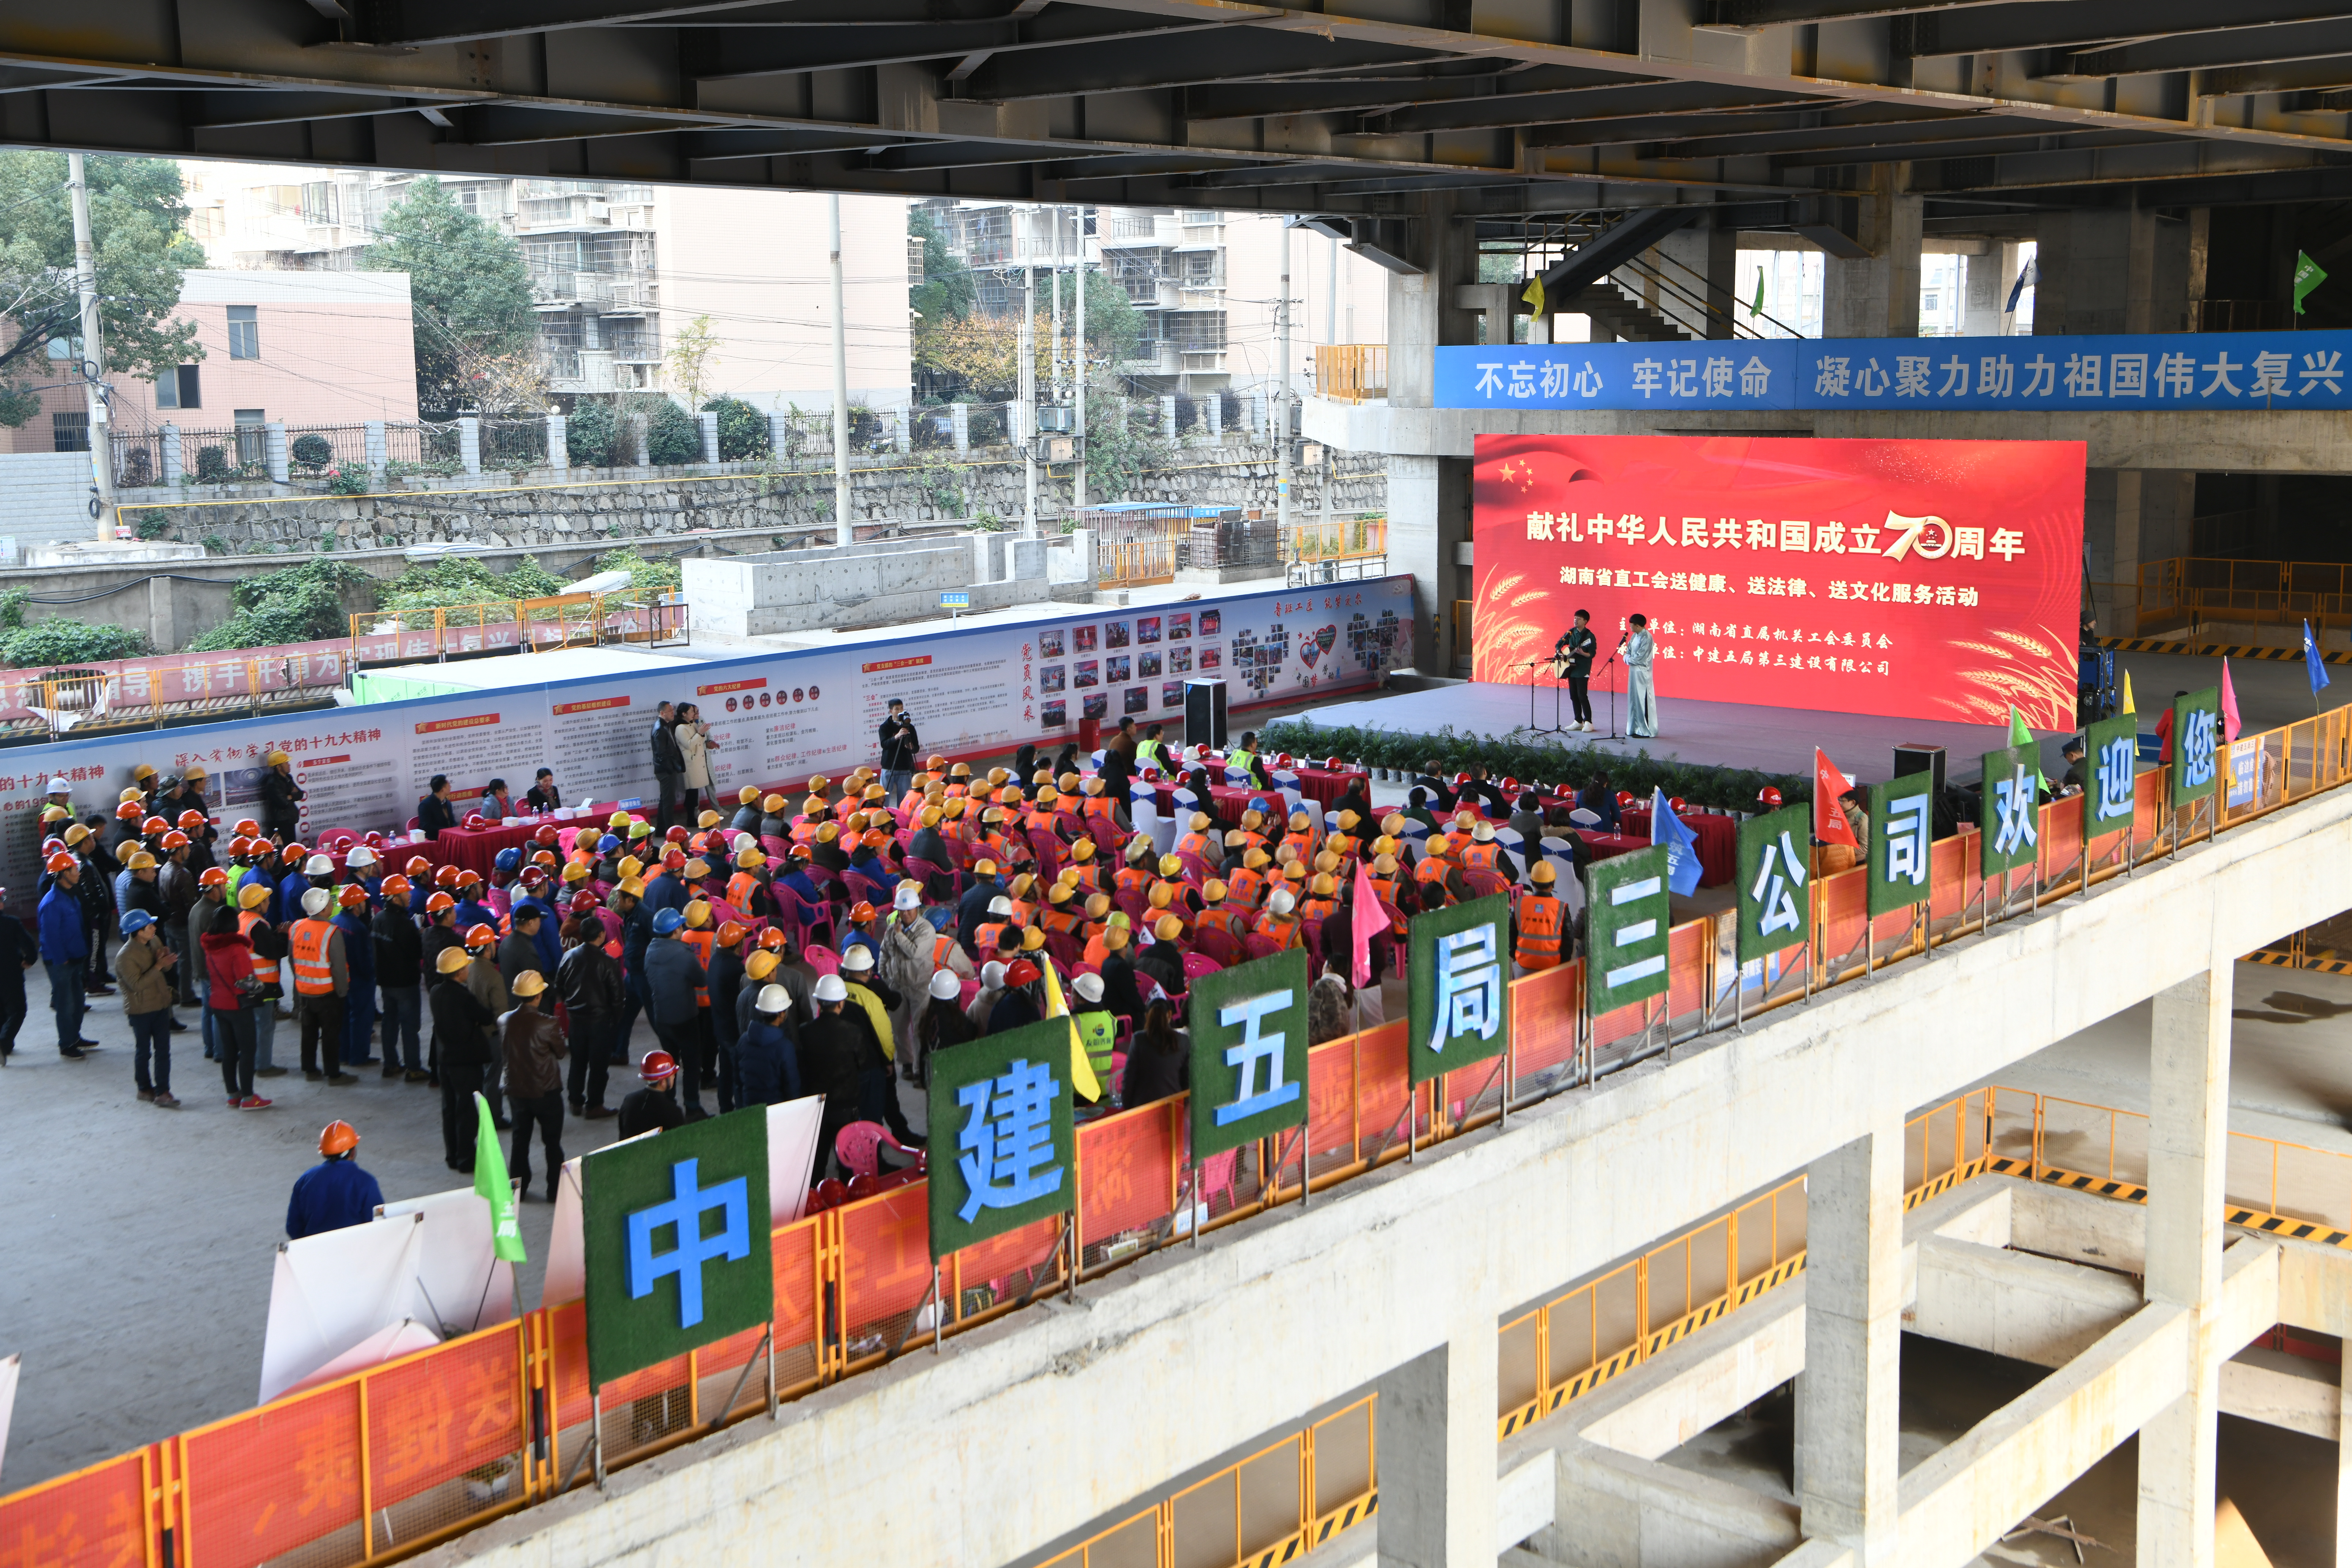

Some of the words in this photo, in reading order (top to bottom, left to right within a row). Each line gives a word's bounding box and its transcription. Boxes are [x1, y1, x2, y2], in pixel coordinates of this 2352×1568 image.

[1475, 359, 1603, 399] 不忘初心
[1632, 356, 1772, 399] 牢记使命
[1814, 350, 2344, 399] 凝心聚力助力祖国伟大复兴
[1527, 510, 2026, 563] 献礼中华人民共和国成立70周年
[1560, 566, 1979, 606] 湖南省直工会送健康、送法律、送文化服务活动
[714, 683, 741, 692] 党的六大纪律
[1021, 643, 1035, 722] 党员风采
[436, 716, 490, 730] 新时代党的建设总要求
[571, 700, 612, 711] 党的基层组织建设
[626, 1157, 749, 1328] 中
[957, 1058, 1064, 1223] 建
[1214, 989, 1300, 1125] 五
[1427, 922, 1500, 1054] 局
[1604, 877, 1665, 988] 三
[1751, 830, 1806, 937] 公
[1886, 793, 1928, 885] 司
[1994, 764, 2037, 855] 欢
[2098, 737, 2134, 822] 迎
[2184, 708, 2216, 787] 您
